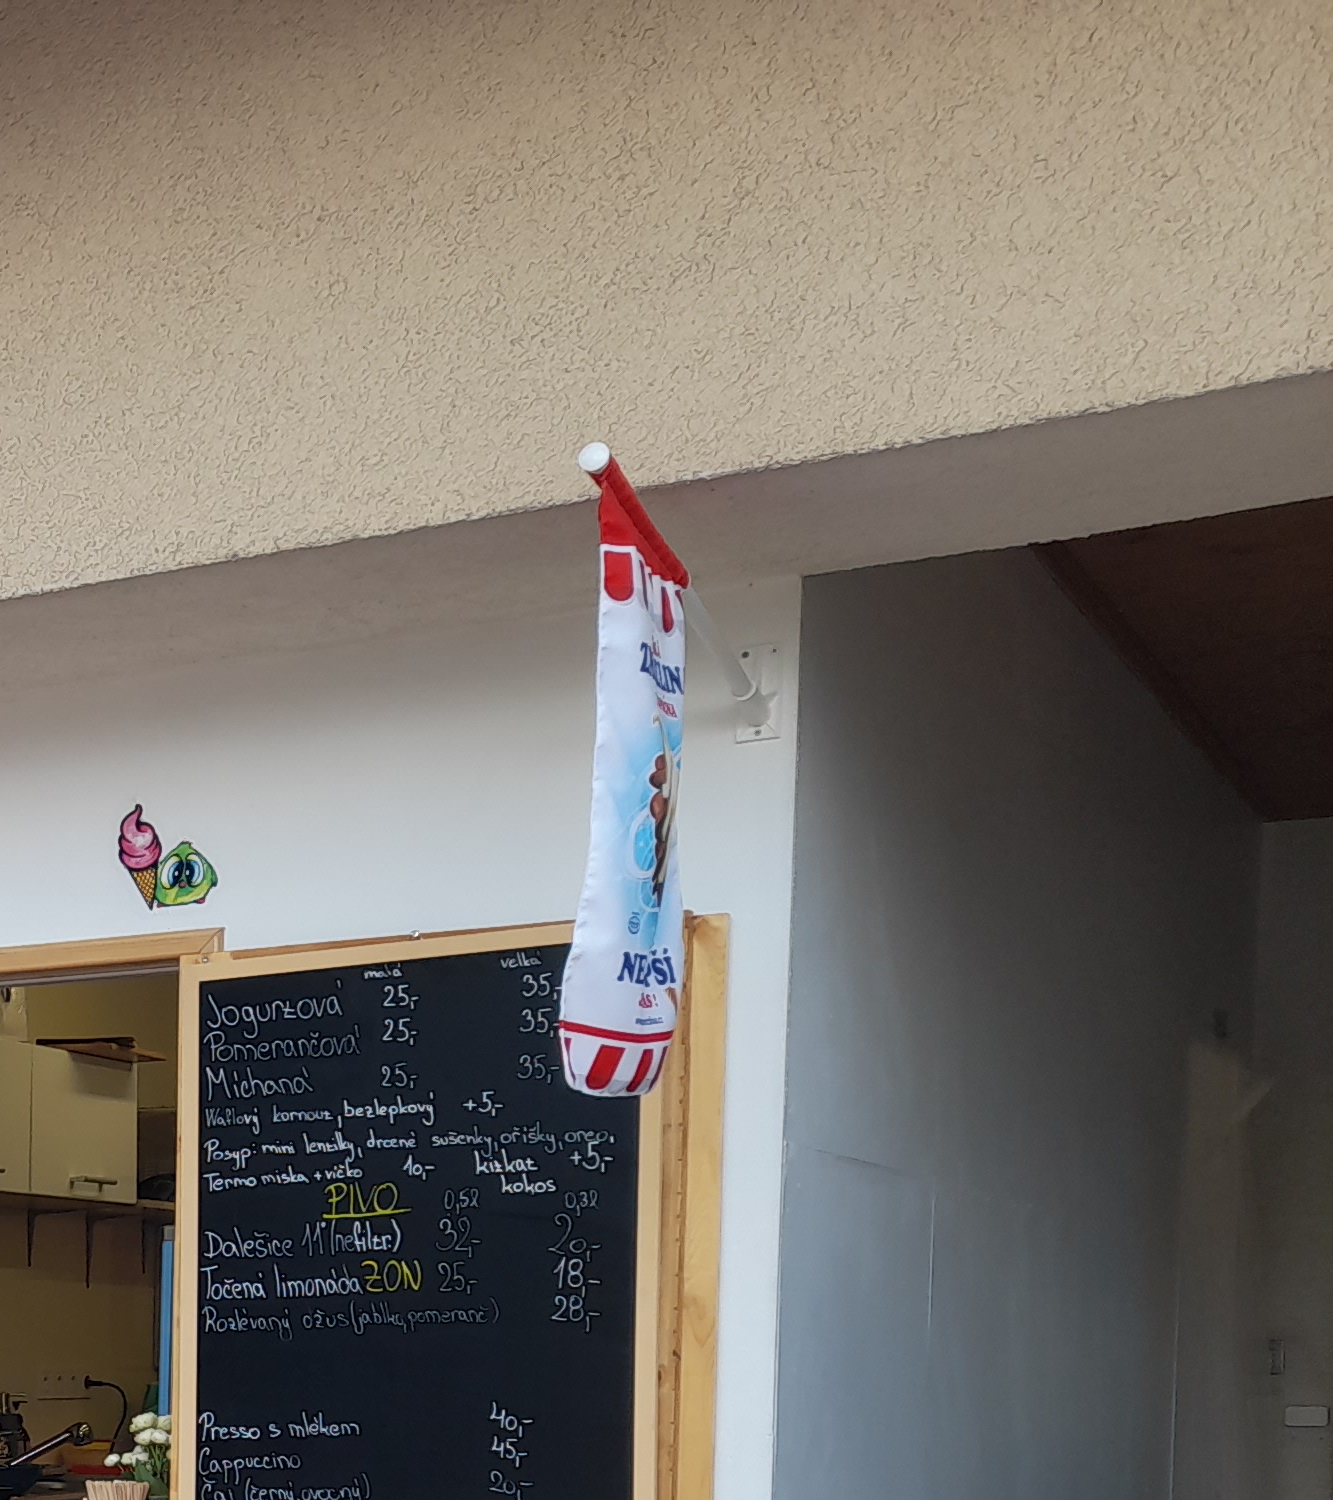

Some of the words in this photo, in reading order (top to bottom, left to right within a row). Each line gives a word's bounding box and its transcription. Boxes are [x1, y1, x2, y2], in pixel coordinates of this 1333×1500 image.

[363, 963, 403, 980] malá
[500, 951, 542, 968] velká
[206, 979, 344, 1039] Jogurtová
[203, 1024, 361, 1062] Pomerančová
[343, 1092, 435, 1126] bezlepkový
[261, 1166, 309, 1185] miska
[473, 1148, 539, 1175] kitkat
[324, 1182, 400, 1216] PIVO
[500, 1174, 558, 1195] kokos
[203, 1226, 294, 1259] Dalešice
[201, 1265, 267, 1301] Točená
[274, 1263, 364, 1298] limonáda
[361, 1260, 422, 1293] ZON
[199, 1411, 261, 1441] Presso
[269, 1423, 282, 1438] s
[288, 1411, 360, 1438] mlékem
[199, 1447, 302, 1485] Cappuccino
